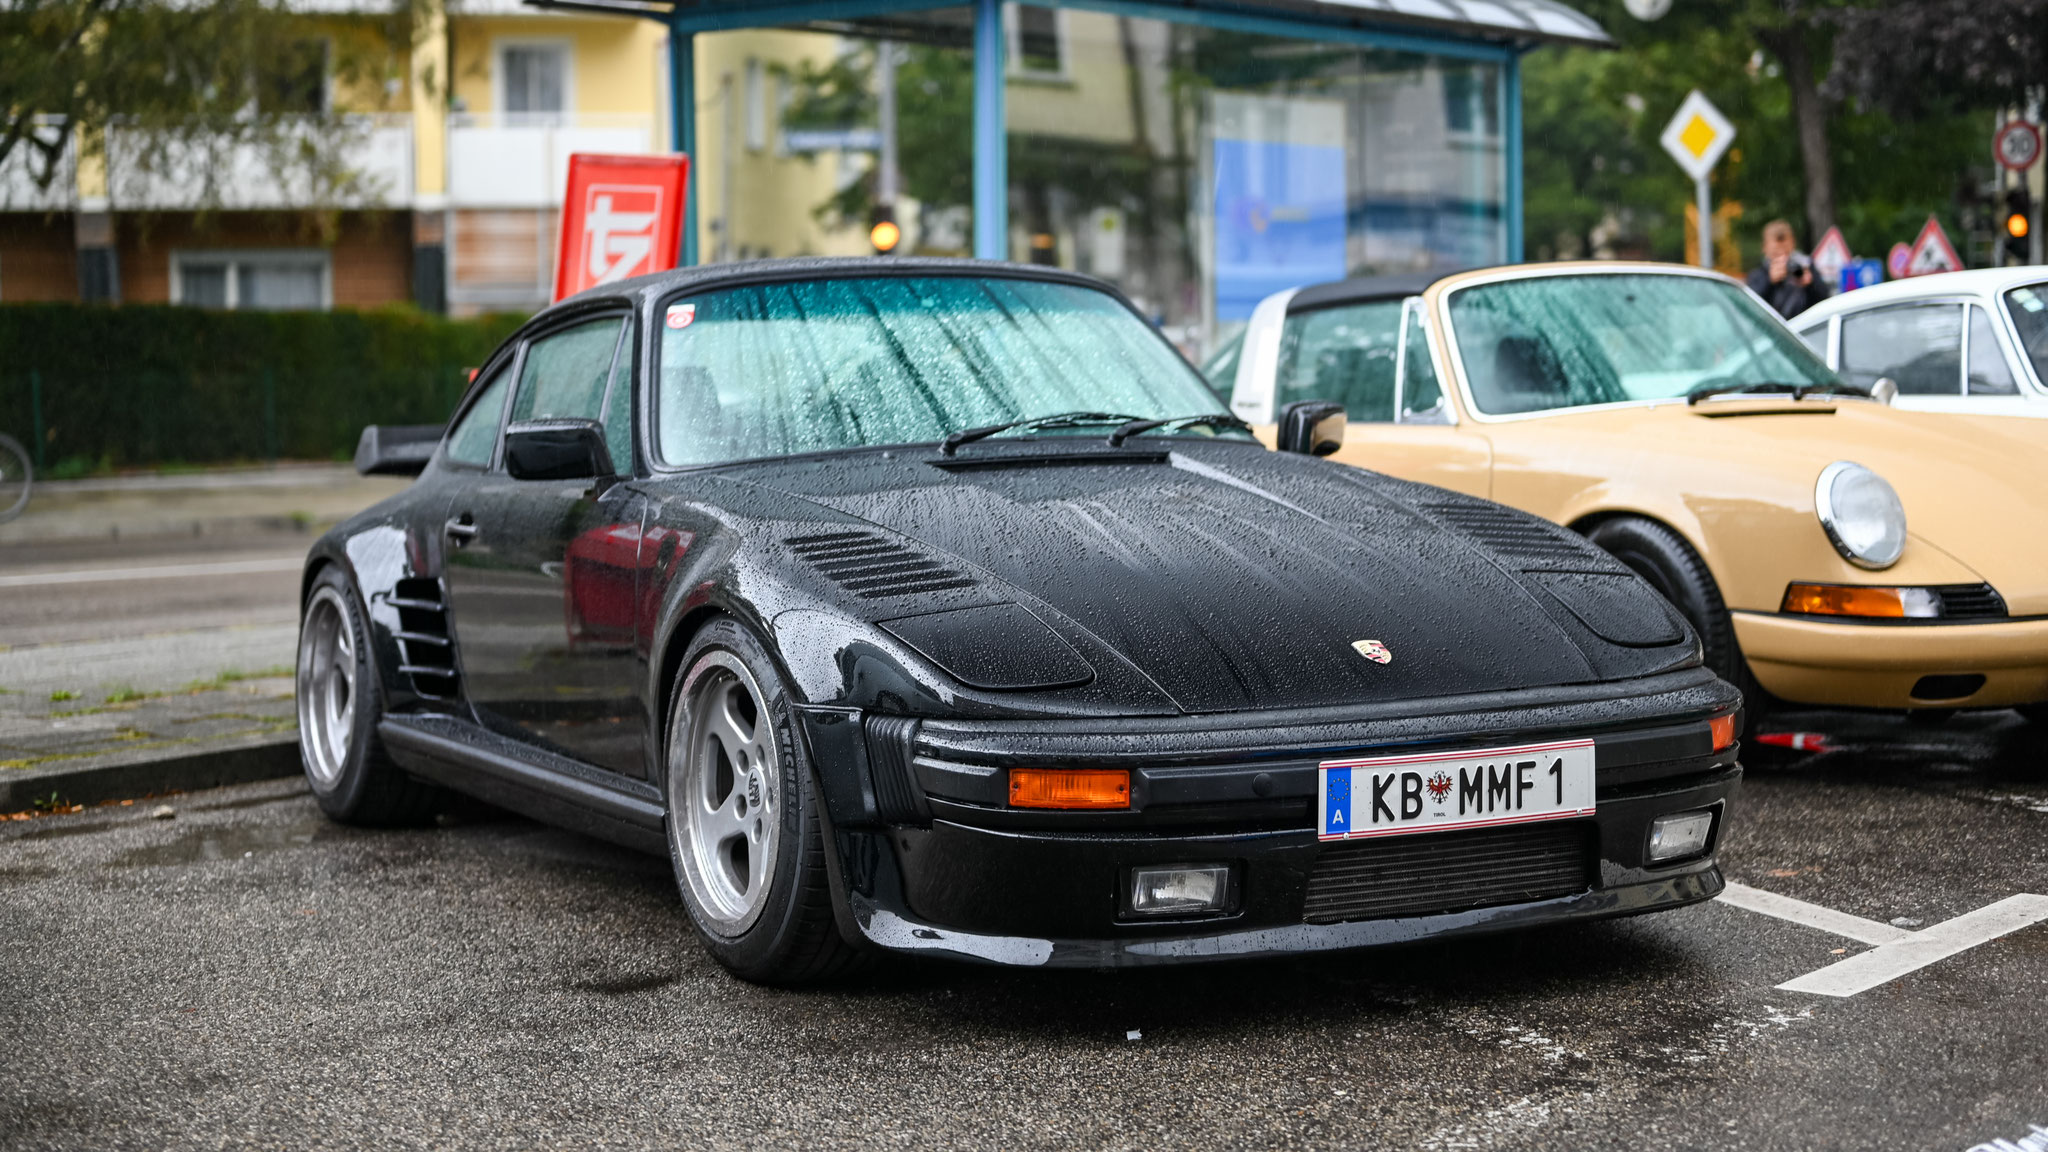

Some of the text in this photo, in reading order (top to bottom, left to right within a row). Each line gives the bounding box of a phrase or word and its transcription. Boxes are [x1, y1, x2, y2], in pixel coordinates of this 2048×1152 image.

[1372, 757, 1563, 823] KB MMF 1
[1332, 808, 1344, 824] A
